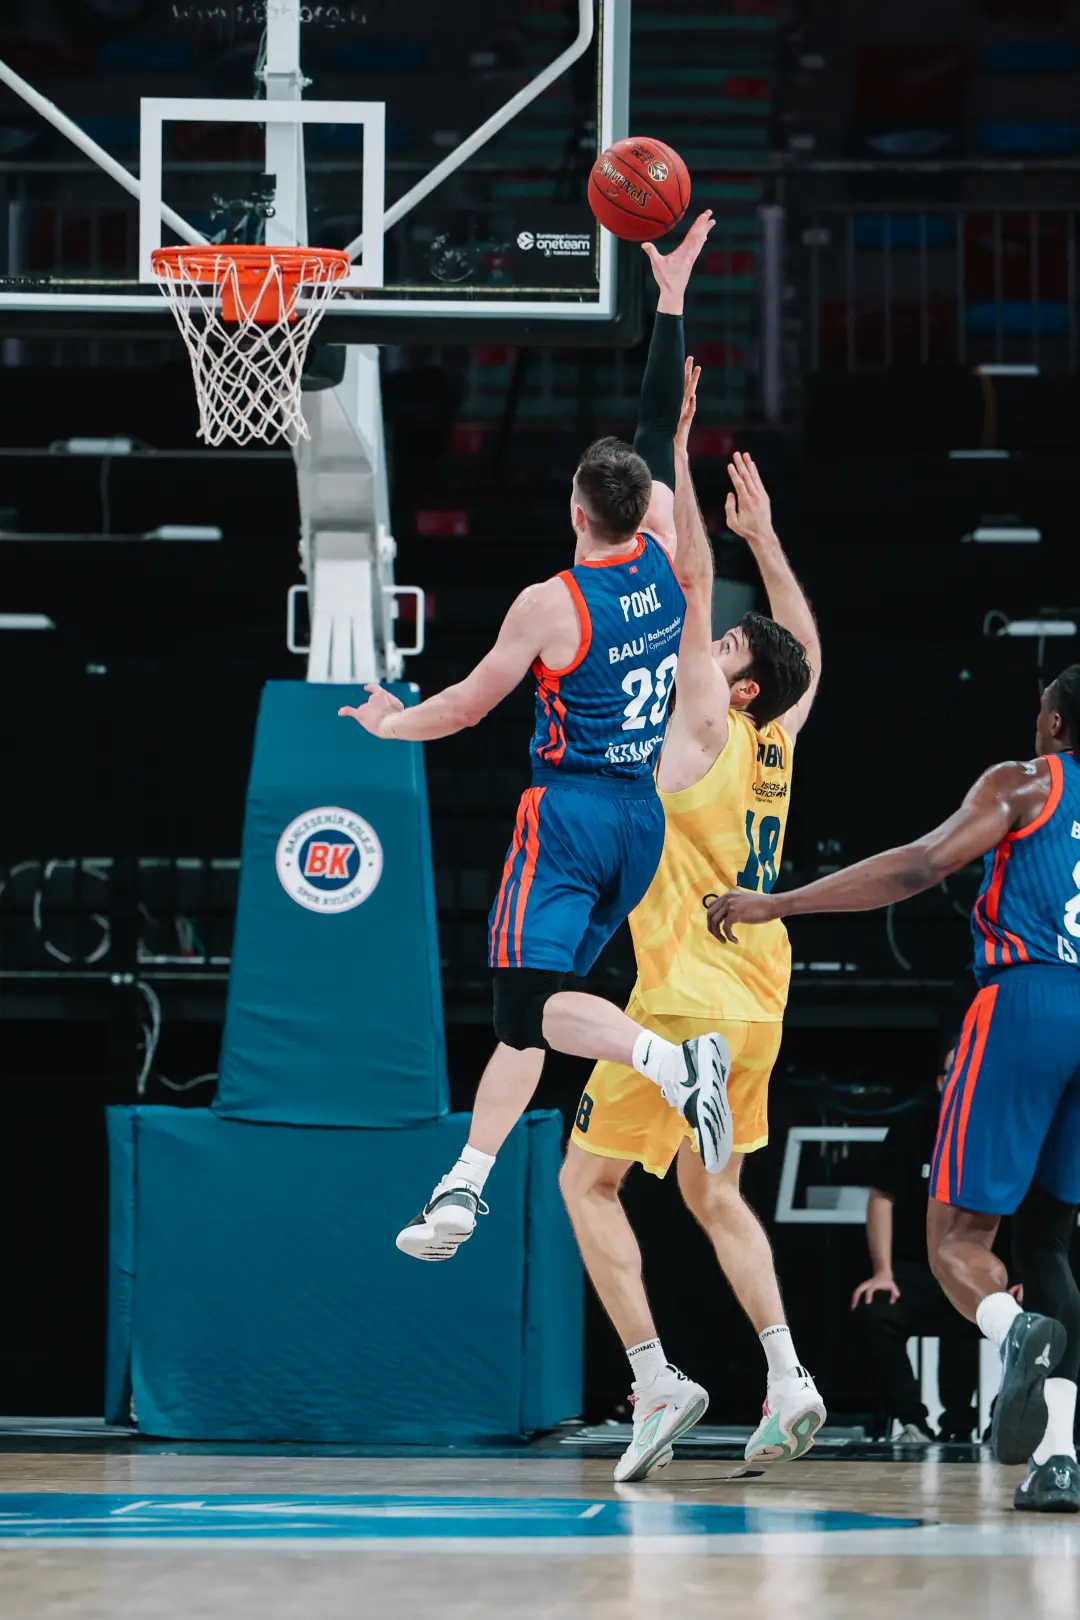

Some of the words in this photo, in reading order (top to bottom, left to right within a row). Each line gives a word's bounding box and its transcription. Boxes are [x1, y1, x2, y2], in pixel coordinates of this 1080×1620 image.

[536, 239, 590, 250] oneteam
[608, 636, 645, 664] BAU
[304, 841, 355, 878] BK
[736, 810, 780, 895] 18
[627, 1342, 656, 1357] ALDING
